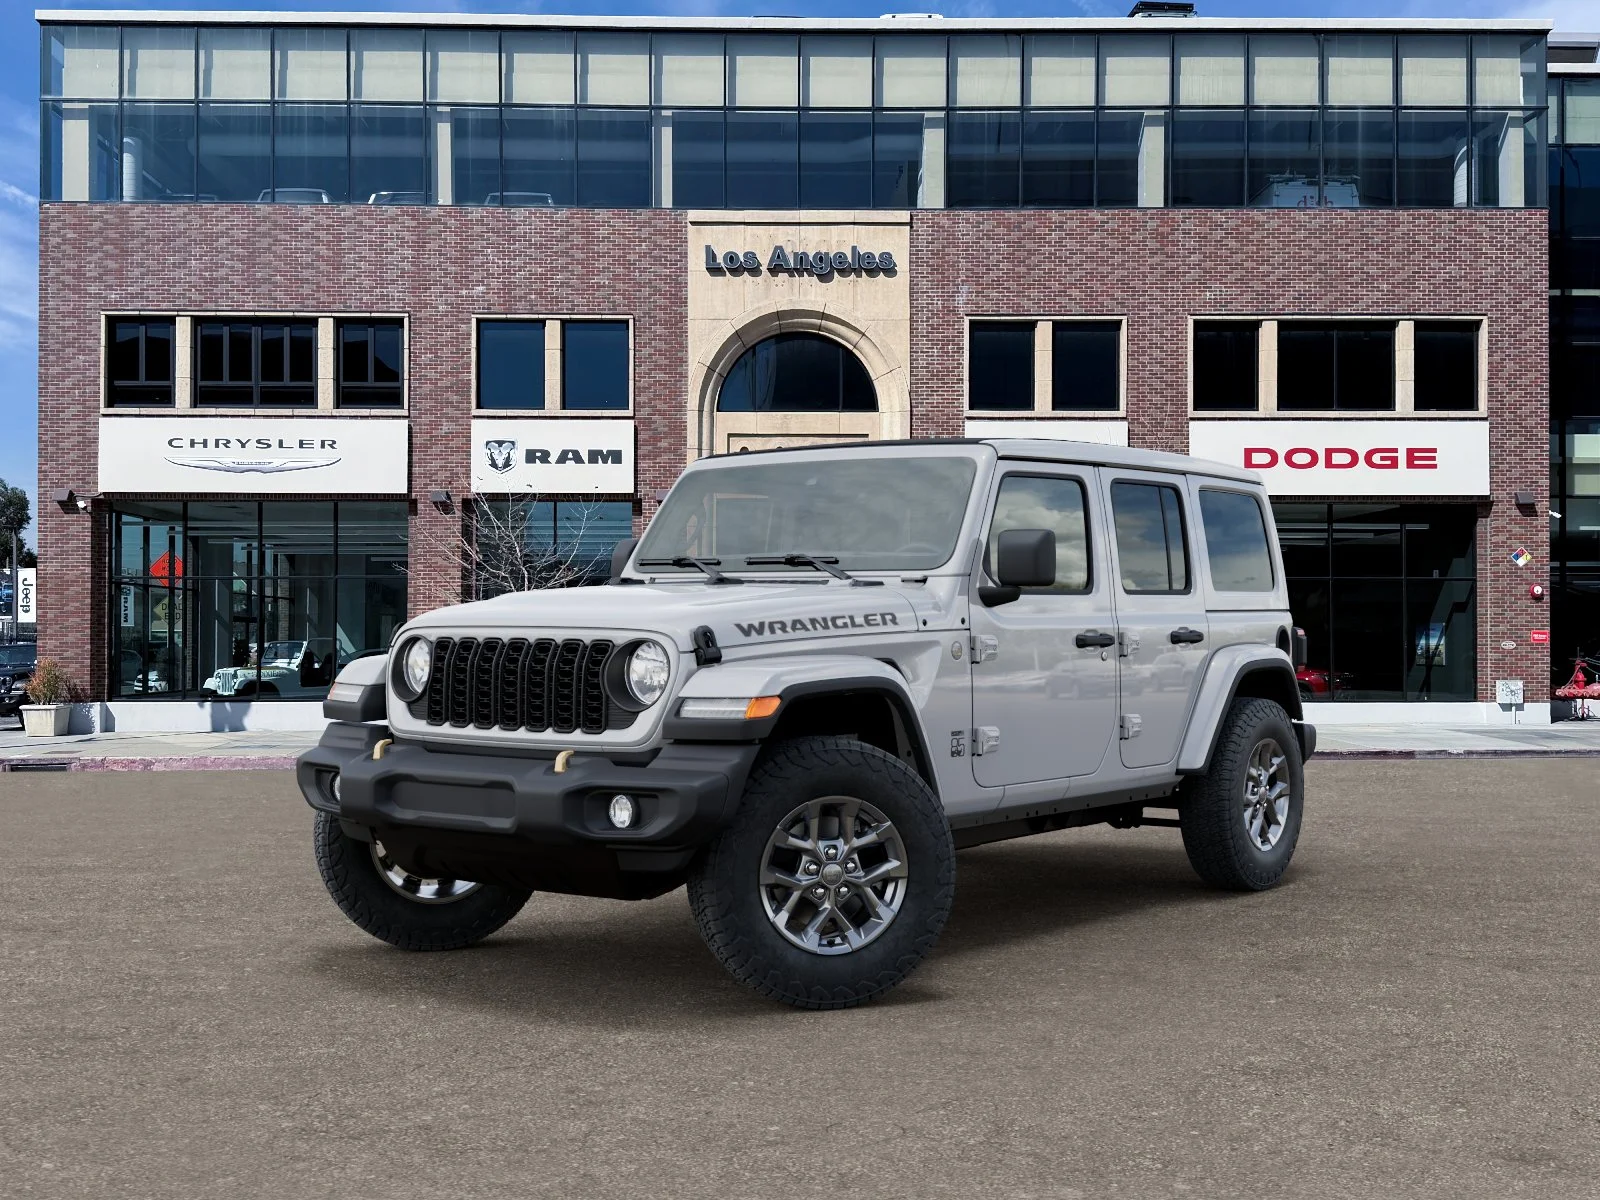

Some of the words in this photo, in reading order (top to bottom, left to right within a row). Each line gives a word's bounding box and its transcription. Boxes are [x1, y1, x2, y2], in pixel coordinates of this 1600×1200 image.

[704, 244, 759, 270] Los
[766, 244, 895, 275] Angeles
[167, 437, 338, 449] CHRYSLER
[525, 448, 623, 464] RAM
[1243, 447, 1438, 470] DODGE
[20, 577, 33, 613] Jeep
[164, 612, 181, 620] ED
[734, 612, 899, 637] WRANGLER
